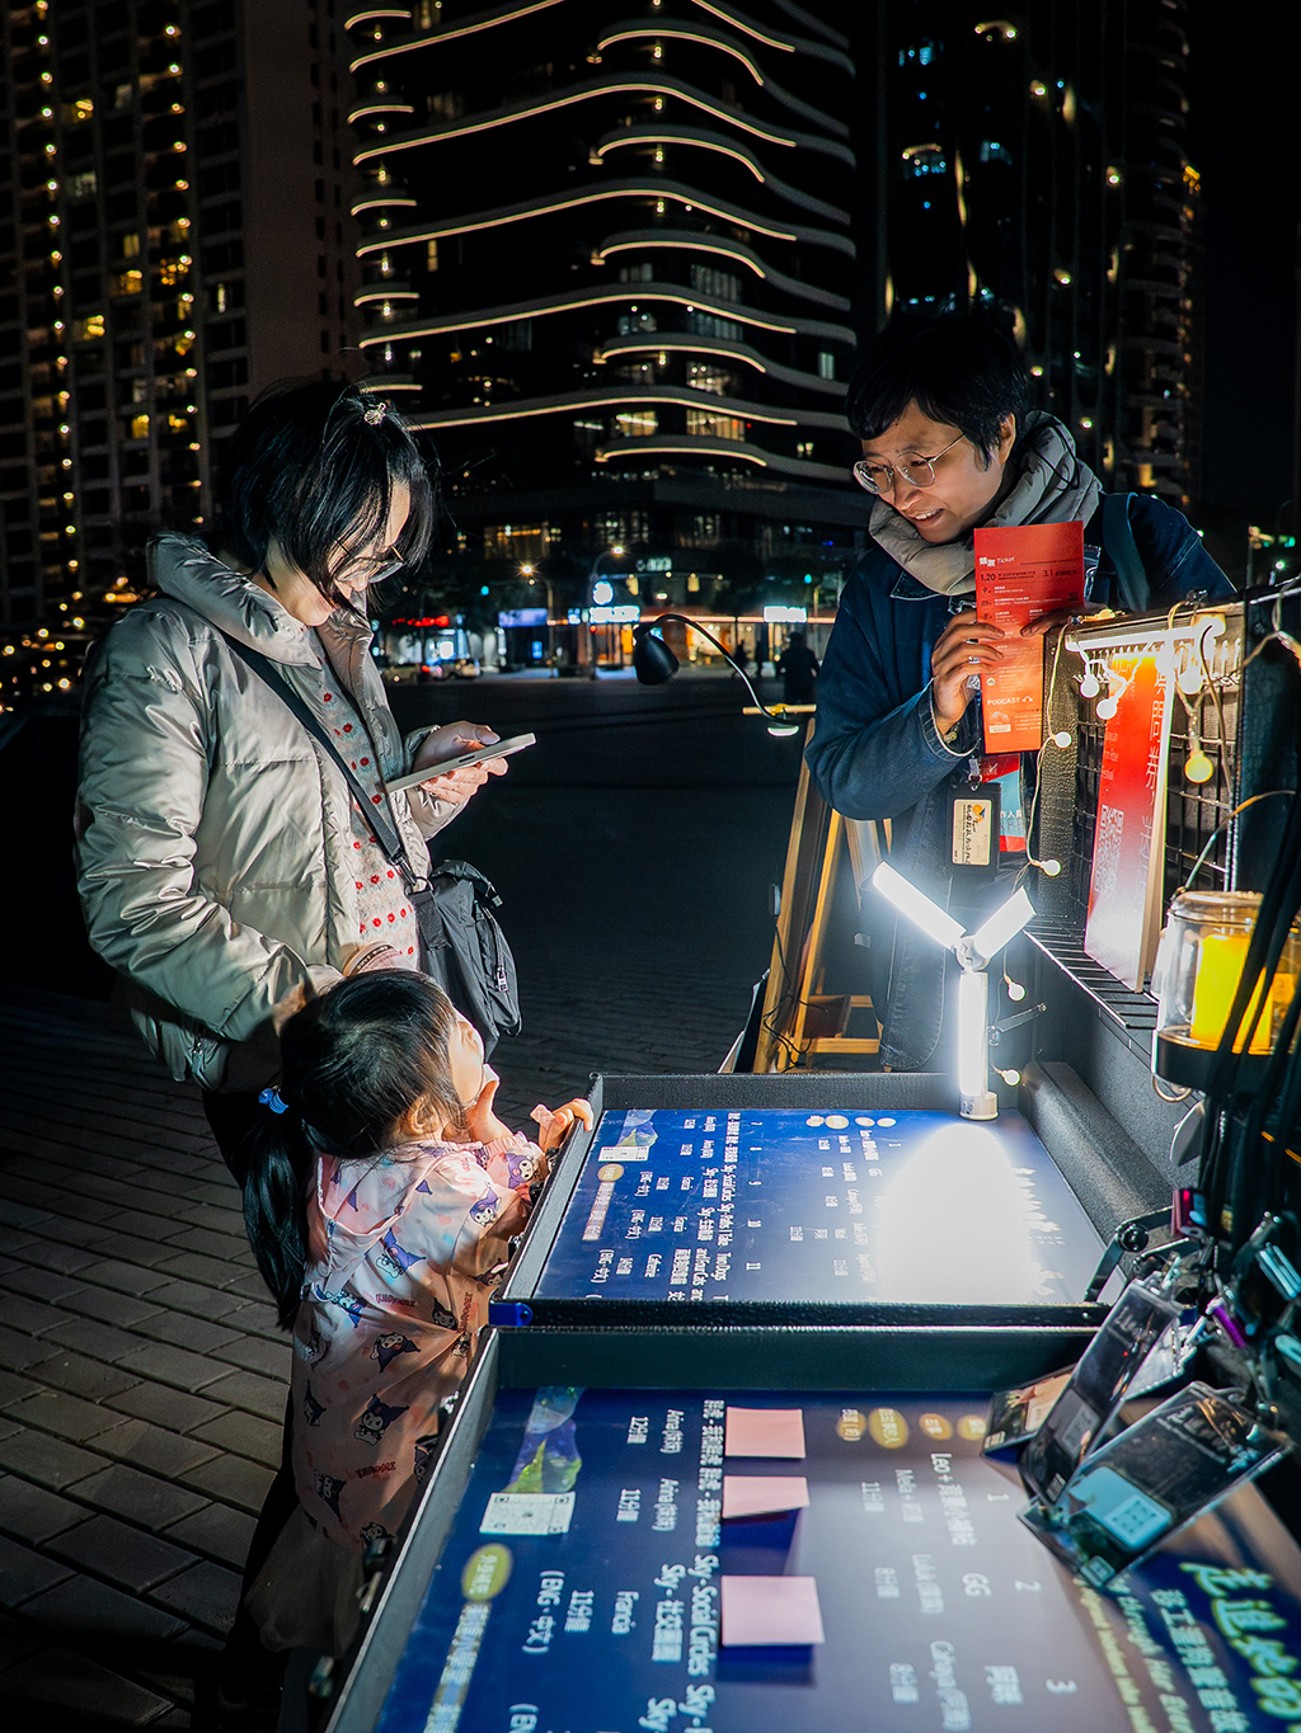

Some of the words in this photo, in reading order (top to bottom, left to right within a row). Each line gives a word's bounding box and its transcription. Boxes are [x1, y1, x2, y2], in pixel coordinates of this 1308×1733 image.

[986, 697, 1021, 706] PODCAST
[931, 1453, 953, 1474] Leo
[988, 1493, 1010, 1502] 1
[653, 1563, 687, 1588] Sky
[688, 1554, 720, 1579] Sky
[962, 1573, 992, 1598] GG
[1014, 1580, 1043, 1593] 2
[611, 1591, 640, 1635] Francia
[690, 1585, 718, 1626] Social
[687, 1626, 717, 1677] Circles
[1178, 1561, 1301, 1733] 走進她的
[1046, 1678, 1078, 1695] 3
[678, 1683, 717, 1717] Sky
[638, 1697, 678, 1732] Sky
